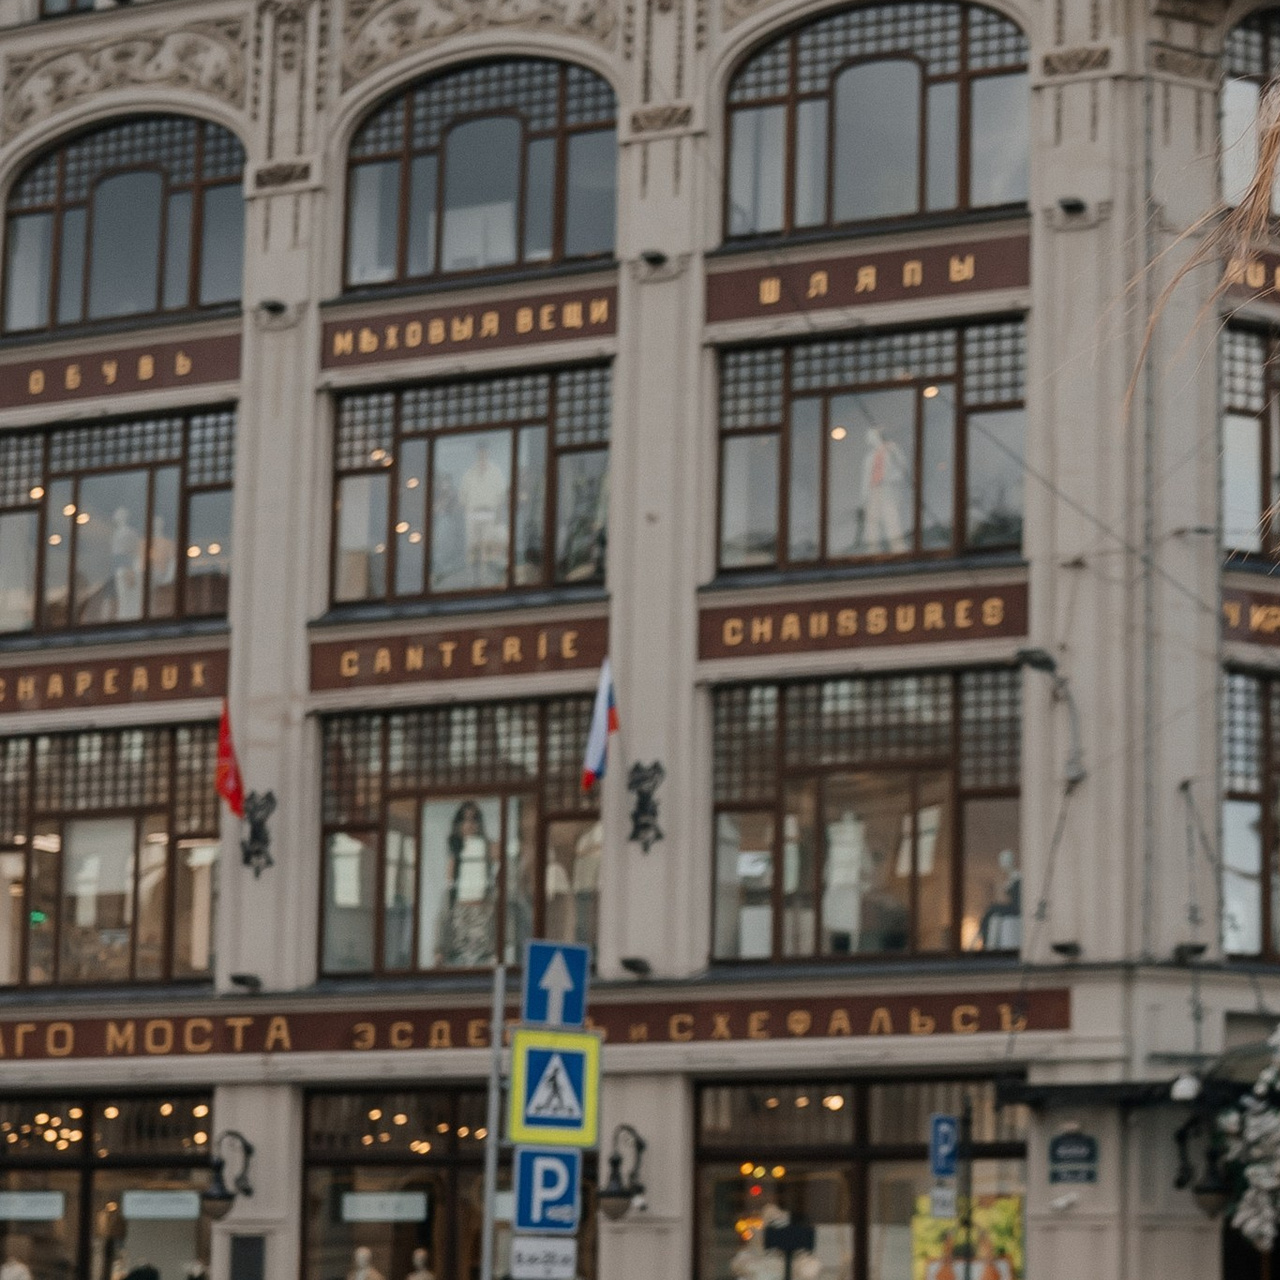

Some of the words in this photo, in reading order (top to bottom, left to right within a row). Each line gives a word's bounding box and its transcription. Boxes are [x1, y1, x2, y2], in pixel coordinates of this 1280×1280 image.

[759, 254, 975, 305] ШЛЯПЫ
[516, 298, 608, 334] ВЕЩИ
[722, 597, 1004, 646] CHAUSSURES
[0, 1021, 74, 1058] ГО
[106, 1016, 291, 1054] МОСТА
[530, 1156, 570, 1223] P
